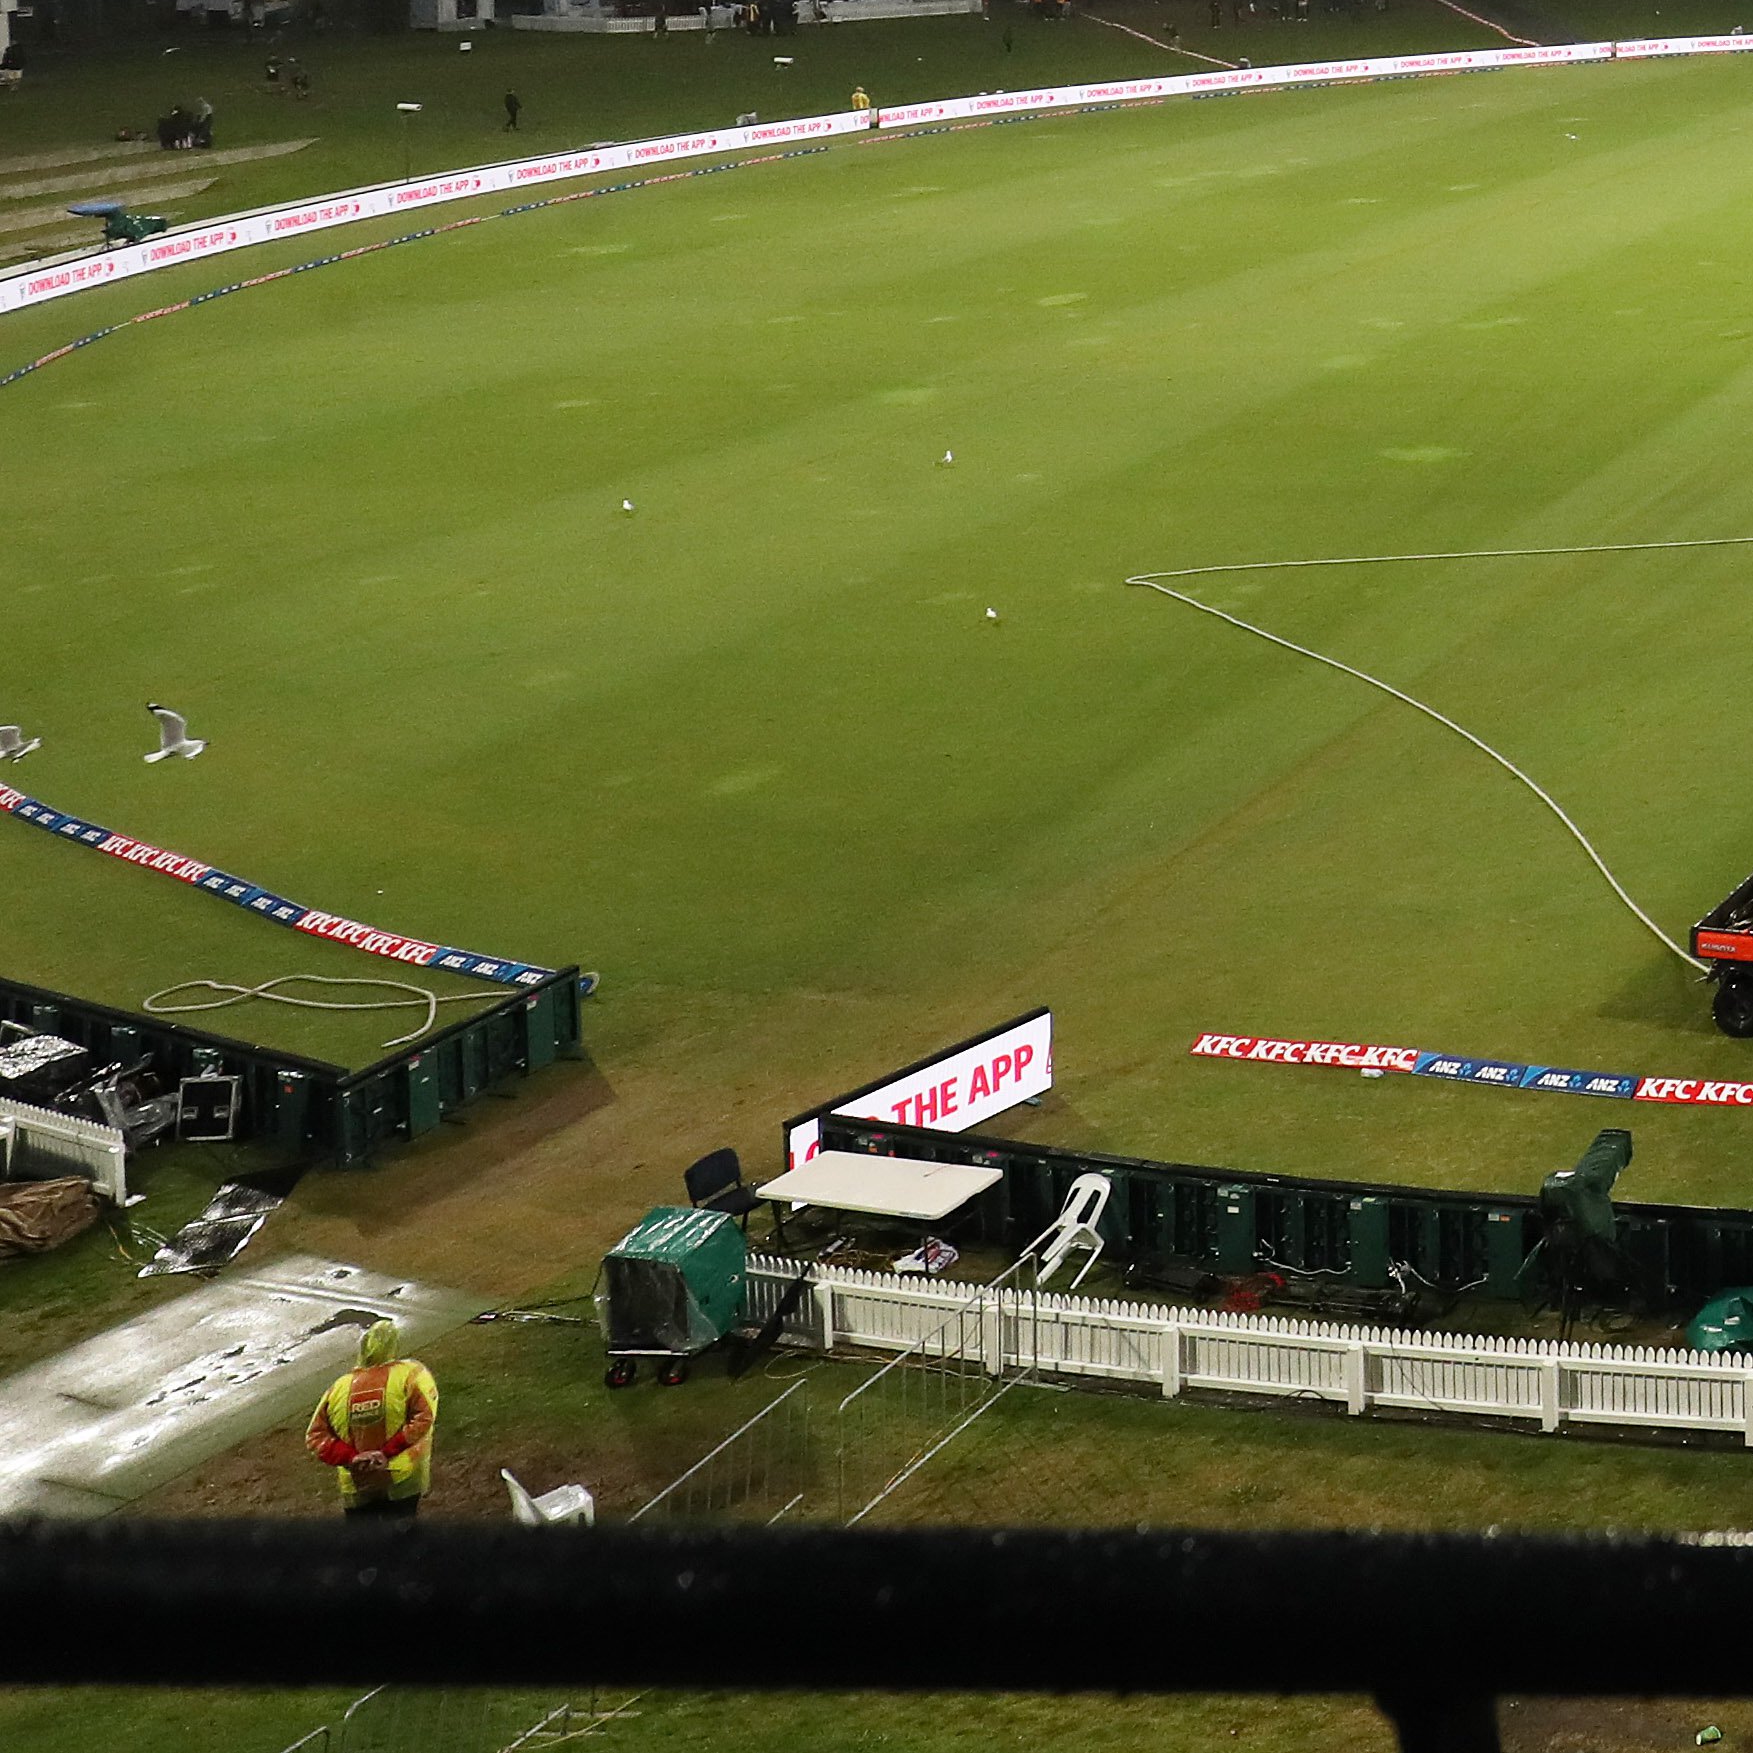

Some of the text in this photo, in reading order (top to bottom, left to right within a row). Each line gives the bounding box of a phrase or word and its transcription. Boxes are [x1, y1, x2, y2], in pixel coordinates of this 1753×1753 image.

[517, 157, 588, 179] DOWNLOAD THE APP
[396, 179, 469, 203] DOWNLOAD THE APP
[274, 203, 349, 231] DOWNLOAD THE APP
[150, 231, 222, 261] DOWNLOAD THE APP
[28, 263, 102, 296] DOWNLOAD THE APP
[99, 836, 215, 881] KFC KFC KFC KFC
[299, 911, 436, 964] KFC KFC KFC KFC
[1193, 1035, 1417, 1068] KFC KFC KFC KFC
[891, 1044, 1033, 1128] THE APP
[1429, 1061, 1619, 1091] ANZ ANZ ANZ ANZ
[1637, 1078, 1696, 1099] KFC
[352, 1399, 380, 1412] RED
